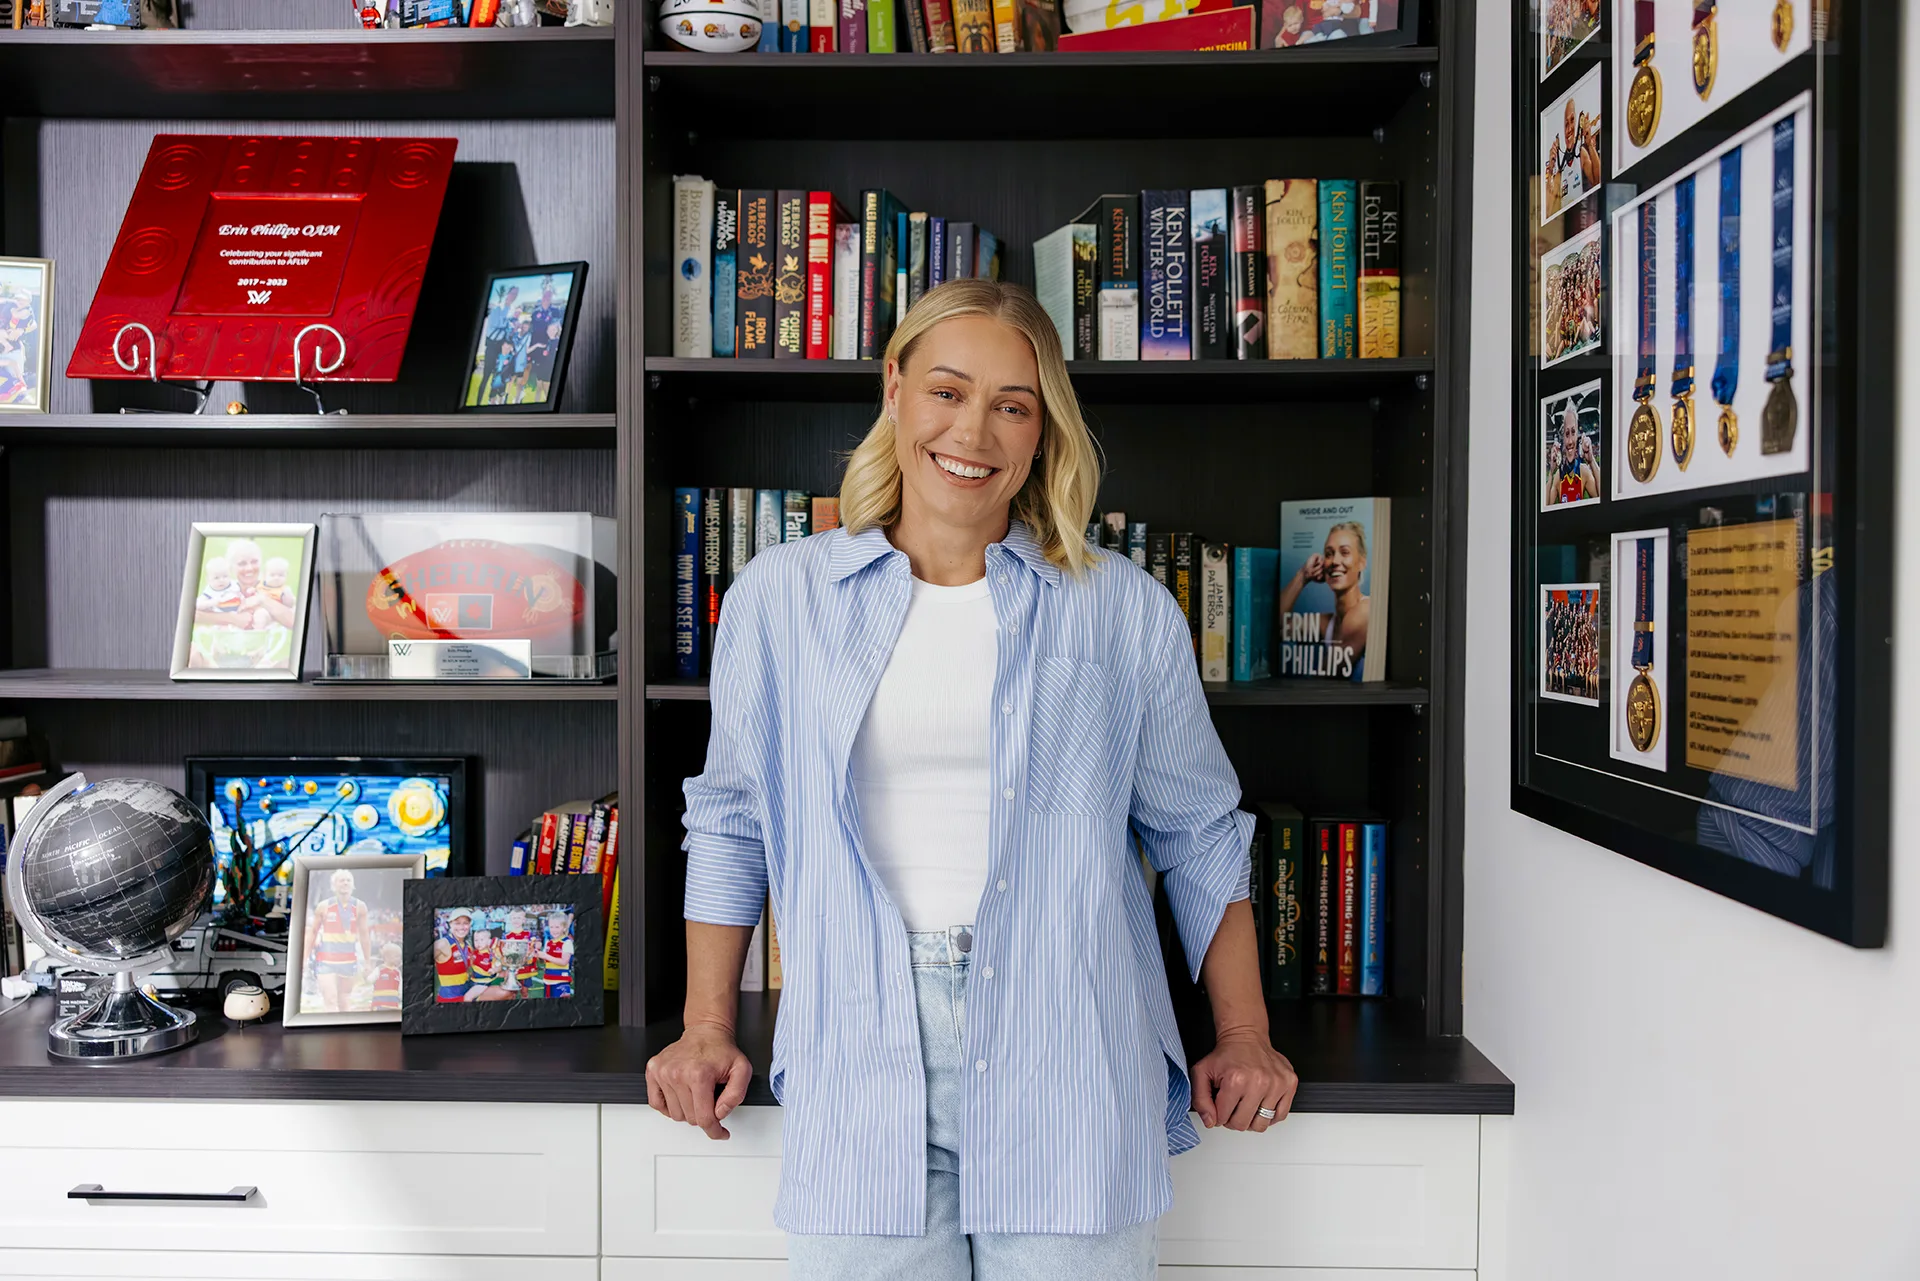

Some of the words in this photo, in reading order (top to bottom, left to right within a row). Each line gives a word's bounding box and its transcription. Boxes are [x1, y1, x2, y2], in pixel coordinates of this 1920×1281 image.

[679, 189, 689, 252] HORSEMAN
[690, 189, 703, 252] BRONZE
[747, 201, 757, 244] YARROS
[757, 197, 767, 249] REBECCA
[809, 203, 829, 235] BLACK
[1112, 207, 1124, 233] KEN
[1285, 209, 1303, 217] KEN
[1331, 190, 1347, 223] KEN
[219, 224, 248, 236] Erin
[250, 223, 300, 239] Phillips
[301, 224, 341, 237] OAM
[716, 201, 727, 250] HAWKINS
[726, 210, 736, 242] PAULA
[782, 201, 791, 246] YARROS
[791, 198, 801, 249] REBECCA
[1166, 207, 1185, 247] KEN
[1246, 216, 1254, 250] FOLLETT
[1364, 195, 1381, 260] FOLLETT
[1382, 211, 1397, 244] KEN
[220, 249, 264, 259] Celebrating
[264, 250, 283, 259] your
[283, 249, 322, 259] significant
[808, 238, 829, 264] WOLF
[1112, 233, 1124, 277] FOLLETT
[1150, 207, 1164, 269] WINTER
[1158, 269, 1164, 280] OF
[1332, 226, 1348, 293] FOLLETT
[228, 258, 276, 266] contribution
[277, 258, 286, 266] to
[286, 258, 310, 266] AFLW
[1201, 244, 1209, 288] FOLLETT
[1209, 255, 1217, 277] KEN
[1248, 253, 1256, 296] JACKDAWS
[237, 278, 259, 286] 2017
[266, 278, 288, 286] 2023
[1077, 269, 1085, 307] FOLLETT
[1084, 279, 1092, 297] KEN
[1166, 252, 1186, 338] FOLLETT
[680, 294, 690, 343] SIMONS
[690, 287, 702, 350] PAULLINA
[1150, 281, 1164, 338] WORLD
[1344, 313, 1352, 329] THE
[1364, 295, 1381, 357] GIANTS
[1382, 300, 1397, 327] FALL
[744, 311, 756, 350] FLAME
[755, 317, 767, 344] IRON
[779, 317, 790, 347] WING
[789, 310, 800, 353] FOURTH
[1325, 319, 1336, 357] MORNING
[1382, 328, 1396, 351] OF
[705, 498, 720, 525] JAMES
[1299, 507, 1321, 515] INSIDE
[1322, 506, 1338, 514] AND
[1338, 505, 1354, 514] OUT
[705, 525, 720, 575] PATTERSON
[677, 554, 694, 581] NOW
[677, 582, 693, 605] YOU
[1207, 570, 1216, 629] PATTERSON
[1215, 583, 1224, 617] JAMES
[676, 606, 693, 629] SEE
[1282, 612, 1321, 643] ERIN
[676, 631, 693, 655] HER
[1281, 644, 1354, 677] PHILLIPS
[64, 838, 91, 853] PACIFIC
[98, 825, 122, 840] OCEAN
[573, 825, 586, 845] LOVE
[592, 809, 605, 842] RAISE
[1283, 828, 1291, 850] COLLINS
[569, 846, 583, 870] BEING
[1278, 858, 1287, 911] SONGBIRDS
[1320, 880, 1329, 917] HUNGER
[1344, 867, 1354, 919] CATCHING
[1287, 894, 1296, 931] BALLAD
[1277, 929, 1287, 966] SNAKES
[1319, 918, 1328, 948] GAMES
[1344, 923, 1353, 947] FIRE
